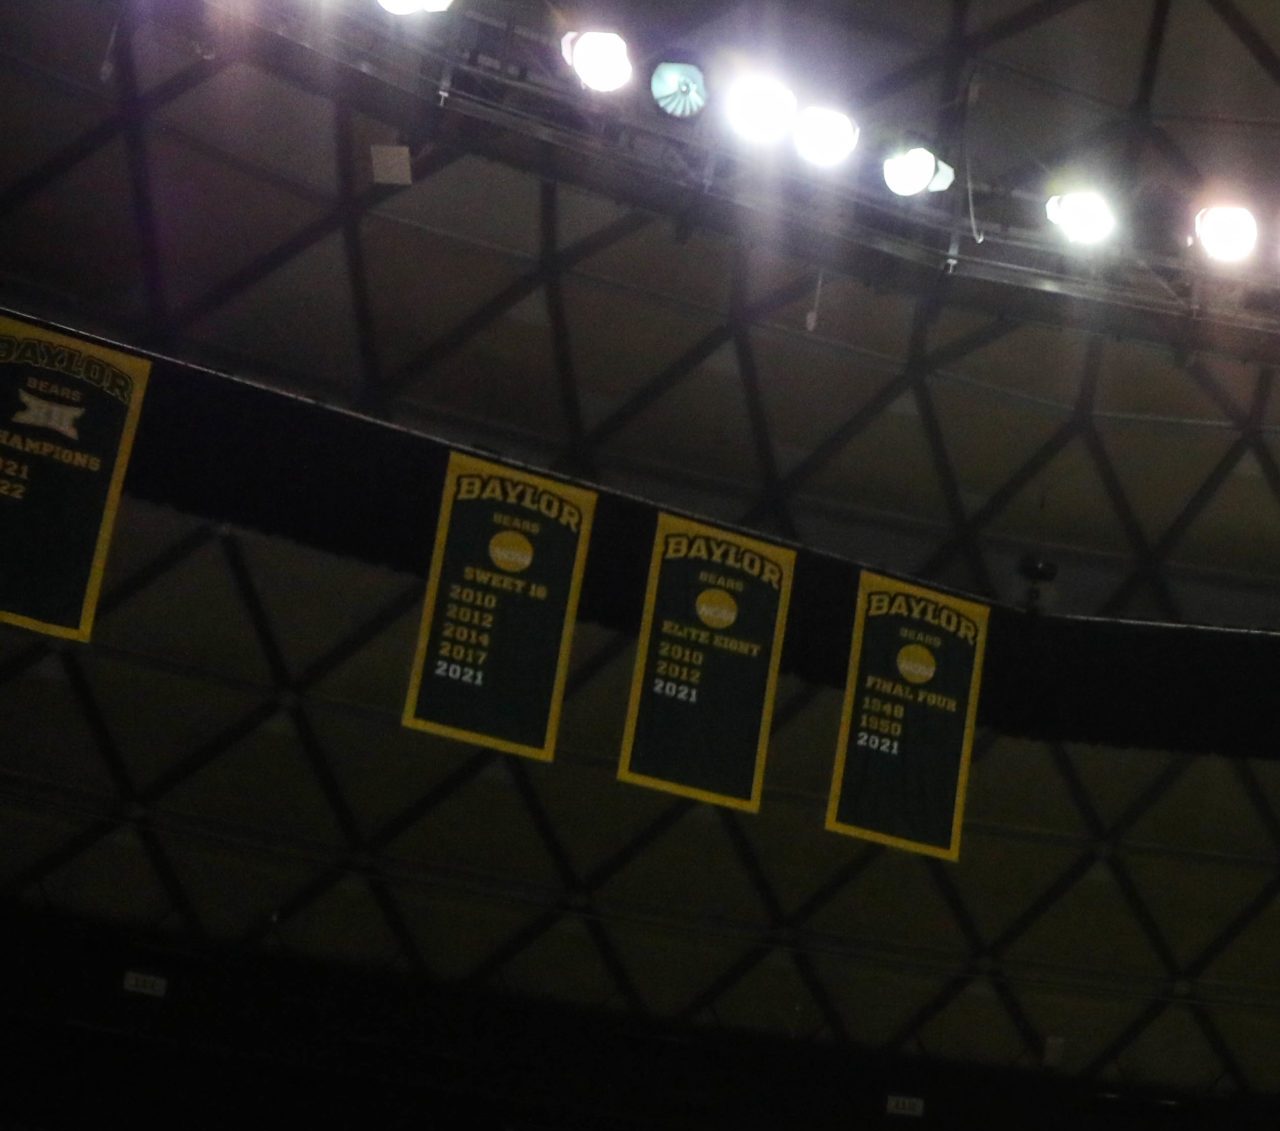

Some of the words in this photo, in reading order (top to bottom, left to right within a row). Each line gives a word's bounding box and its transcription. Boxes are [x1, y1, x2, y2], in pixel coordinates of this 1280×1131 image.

[26, 377, 83, 402] BEARS
[0, 430, 101, 472] HAMPIONS
[456, 476, 583, 534] BAYLOR
[664, 536, 782, 591] BAYLOR
[464, 566, 529, 594] SWEET
[448, 585, 498, 609] 2010
[446, 604, 495, 629] 2012
[867, 593, 977, 646] BAYLOR
[661, 619, 713, 646] ELITE
[438, 642, 489, 666] 2017
[658, 641, 704, 666] 2010
[434, 662, 485, 686] 2021
[656, 660, 702, 685] 2012
[653, 678, 698, 704] 2021
[865, 675, 915, 702] FINAL
[916, 689, 958, 713] FOUR
[856, 732, 900, 756] 2021
